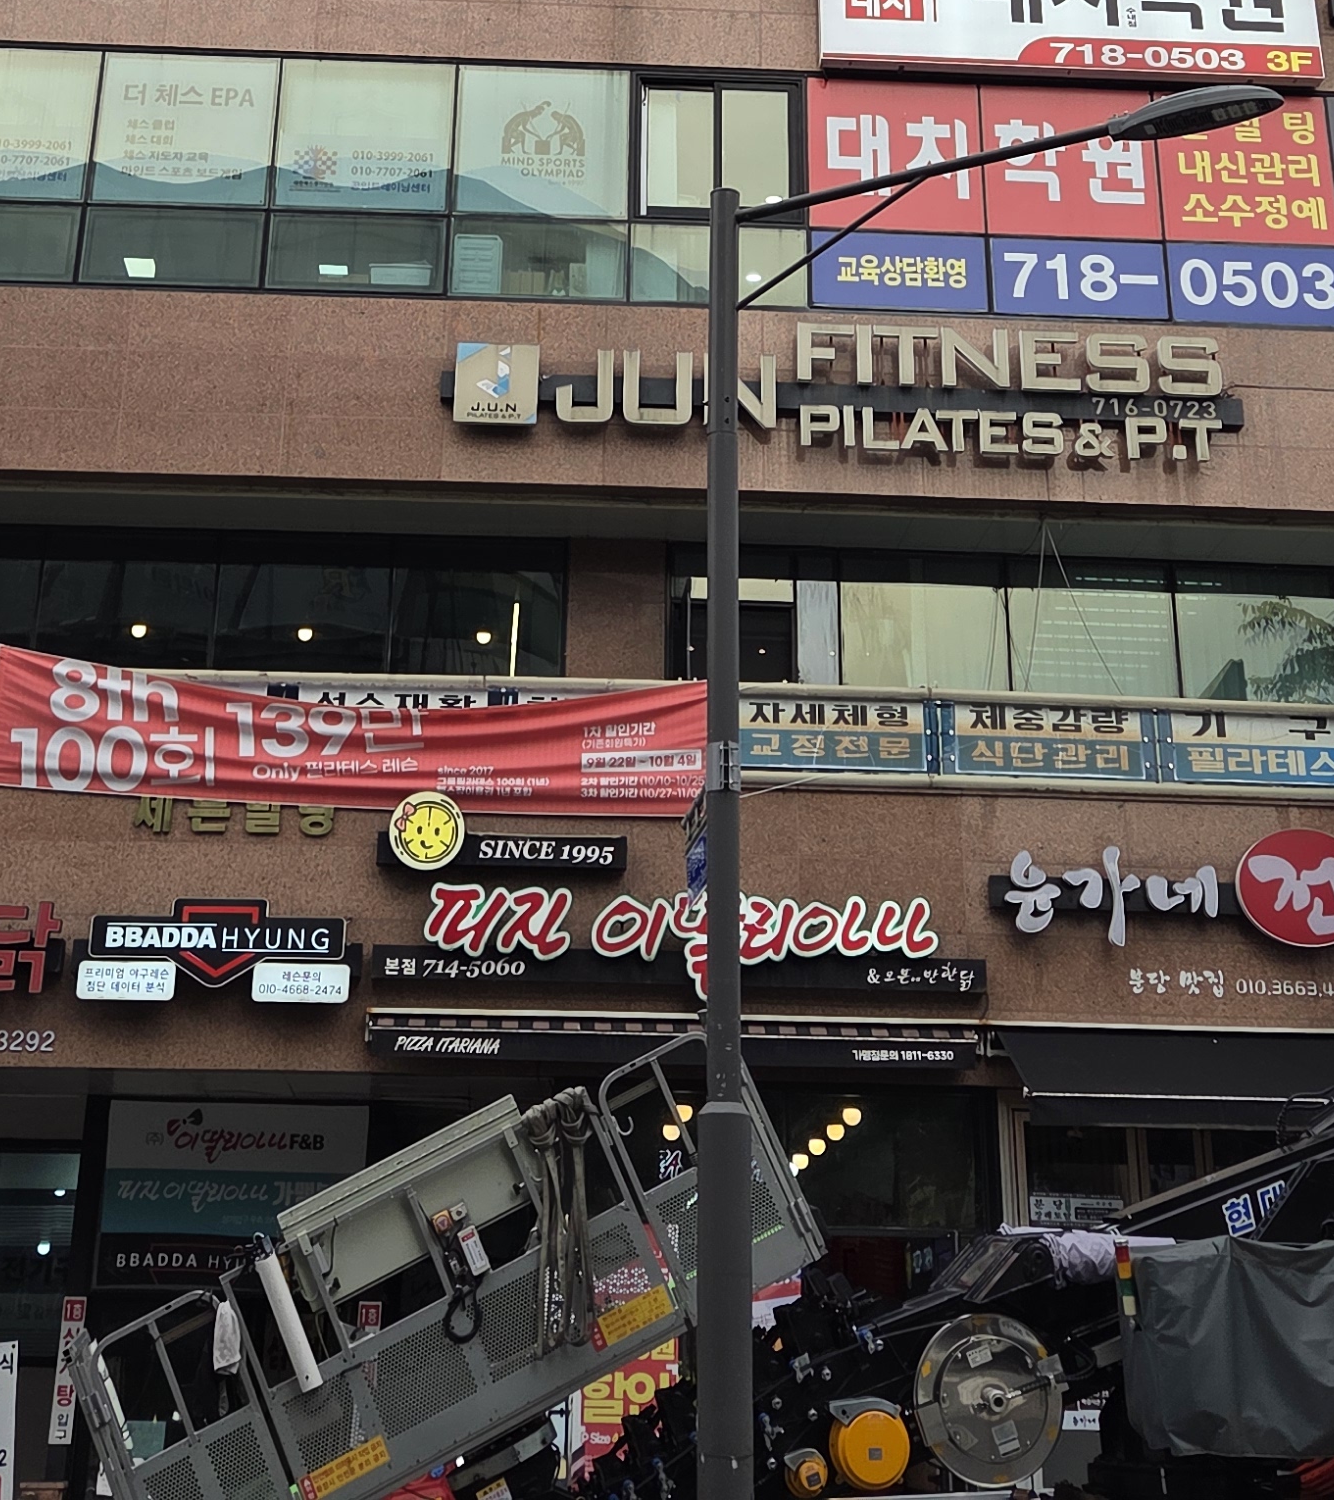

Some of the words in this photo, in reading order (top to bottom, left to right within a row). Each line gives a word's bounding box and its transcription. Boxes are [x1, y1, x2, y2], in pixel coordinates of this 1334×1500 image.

[1050, 41, 1246, 70] 718-0503
[1266, 50, 1313, 72] 3F
[123, 83, 148, 107] 더
[154, 84, 204, 107] 체스
[210, 87, 256, 107] EPA
[352, 150, 434, 163] 010-3999-2061
[501, 156, 535, 167] MIND
[538, 157, 586, 168] SPORTS
[825, 114, 1145, 205] 대치학원
[1177, 150, 1321, 187] 내신관리
[351, 166, 434, 178] 010-7707-2061
[520, 167, 585, 179] OLYMPIAD
[1181, 192, 1328, 230] 소수정예
[836, 255, 968, 289] 교육상담환영
[797, 322, 1223, 397] FITNESS
[556, 348, 776, 429] JUN
[470, 402, 517, 412] J.U.N
[1092, 397, 1217, 419] 716-0723
[799, 405, 1064, 455] PILATES
[49, 657, 180, 723] 8th
[749, 703, 910, 729] 자세체형
[969, 706, 1130, 737] 체중감량
[225, 701, 430, 758] 139만
[583, 725, 602, 738] 1차
[605, 722, 656, 738] 할인기간
[9, 725, 215, 792] 100회
[748, 734, 912, 761] 교정전문
[970, 742, 1130, 773] 식단관리
[252, 762, 300, 783] Only
[305, 759, 378, 779] 필라테스
[382, 757, 418, 774] 레슨
[469, 766, 494, 775] 2017
[586, 756, 606, 769] 9월
[609, 755, 637, 769] 22일
[648, 754, 674, 768] 10월
[677, 754, 696, 767] 4일
[478, 839, 555, 862] SINCE
[560, 843, 615, 867] 1995
[424, 882, 573, 960] 피자
[105, 925, 217, 949] BBADDA
[222, 927, 330, 950] HYUNG
[84, 968, 124, 980] 프리미엄
[130, 968, 170, 980] 야구레슨
[283, 971, 322, 983] 레슨문의
[384, 957, 416, 976] 본점
[422, 957, 526, 979] 714-5060
[86, 981, 105, 993] 첨단
[111, 981, 141, 993] 데이터
[145, 981, 166, 993] 분석
[258, 984, 343, 996] 010-4668-2474
[1129, 968, 1170, 996] 분당
[1178, 968, 1224, 999] 맛집
[395, 1036, 432, 1052] PIZZA
[436, 1037, 500, 1054] ITARIANA
[852, 1049, 898, 1061] 가맹점문의
[901, 1050, 954, 1061] 1811-6330
[116, 1253, 198, 1268] BBADDA
